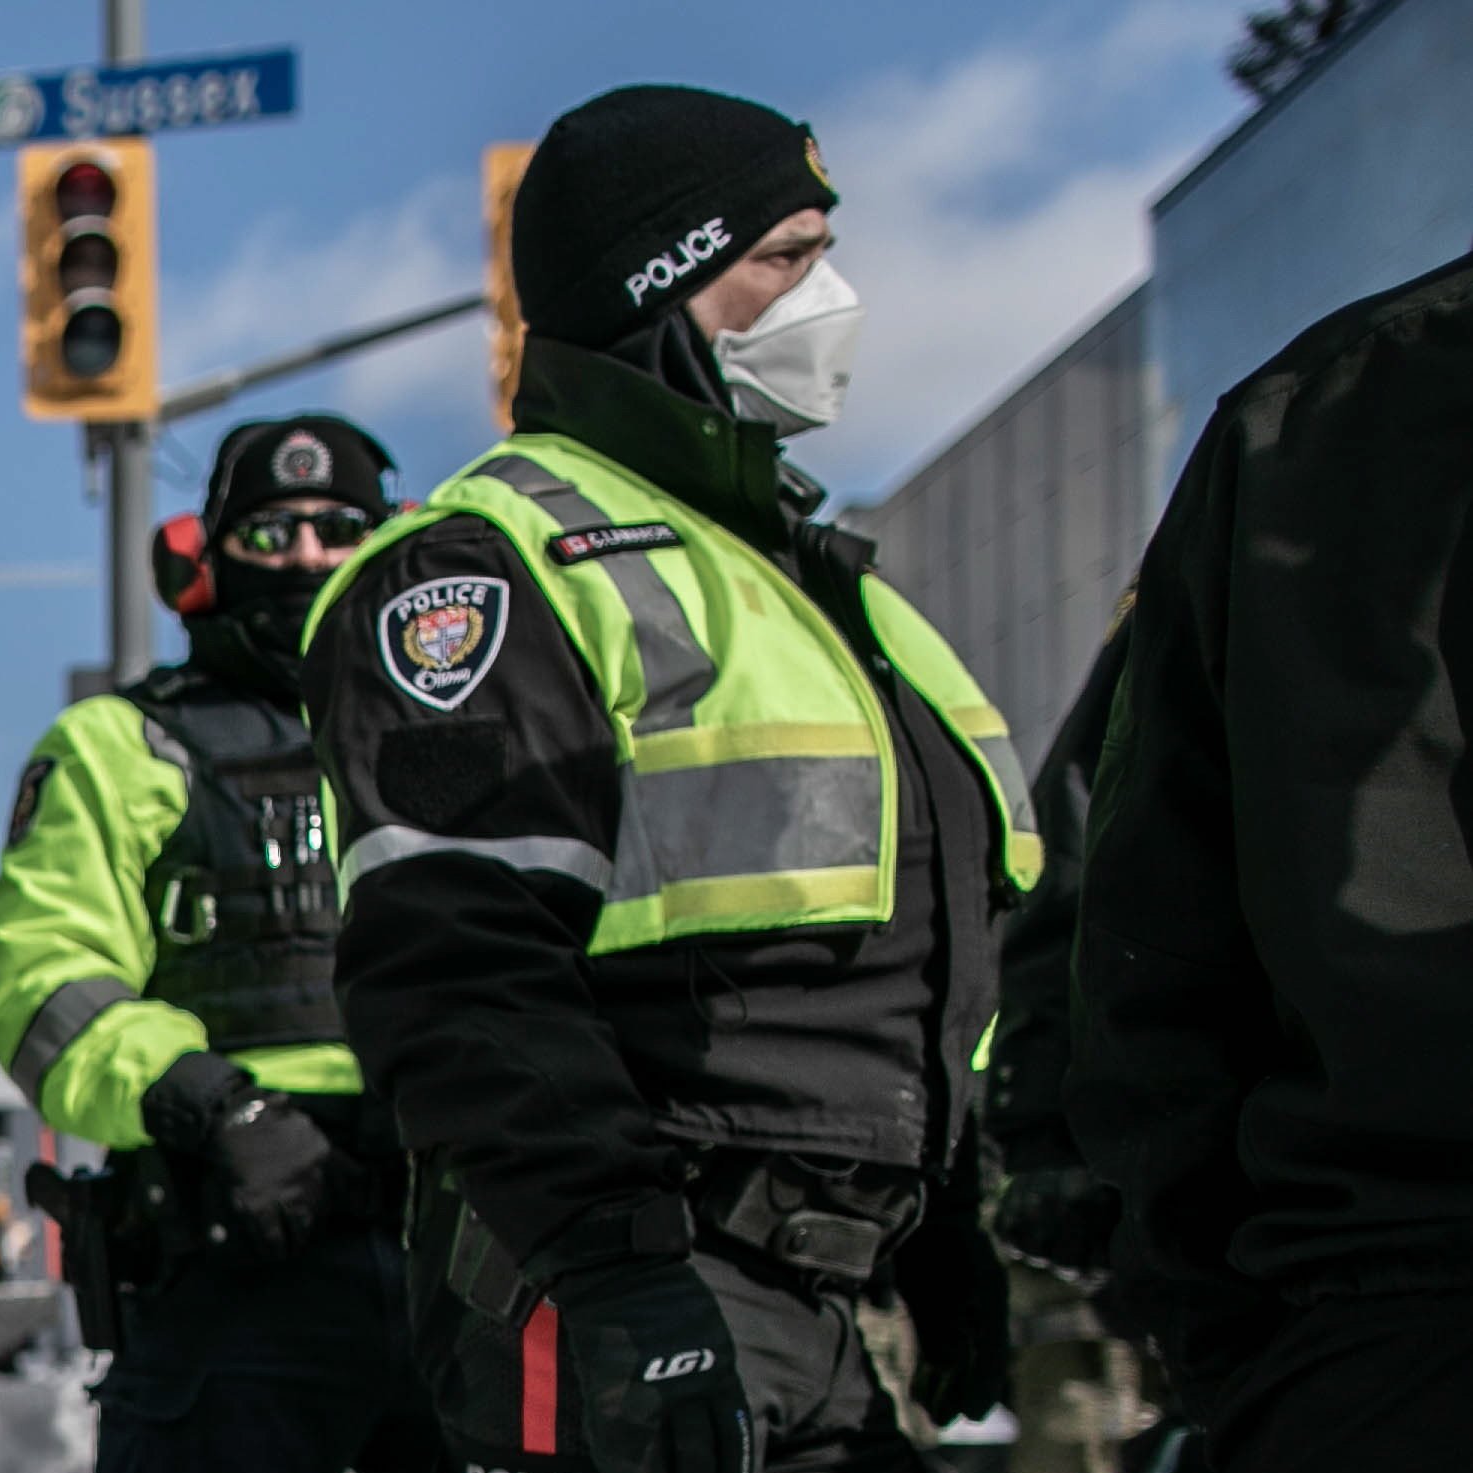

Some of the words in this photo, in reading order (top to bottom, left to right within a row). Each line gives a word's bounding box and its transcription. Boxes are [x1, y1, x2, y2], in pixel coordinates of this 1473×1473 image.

[62, 66, 260, 135] Sussex
[625, 217, 733, 307] POLICE
[397, 583, 488, 622] POLICE
